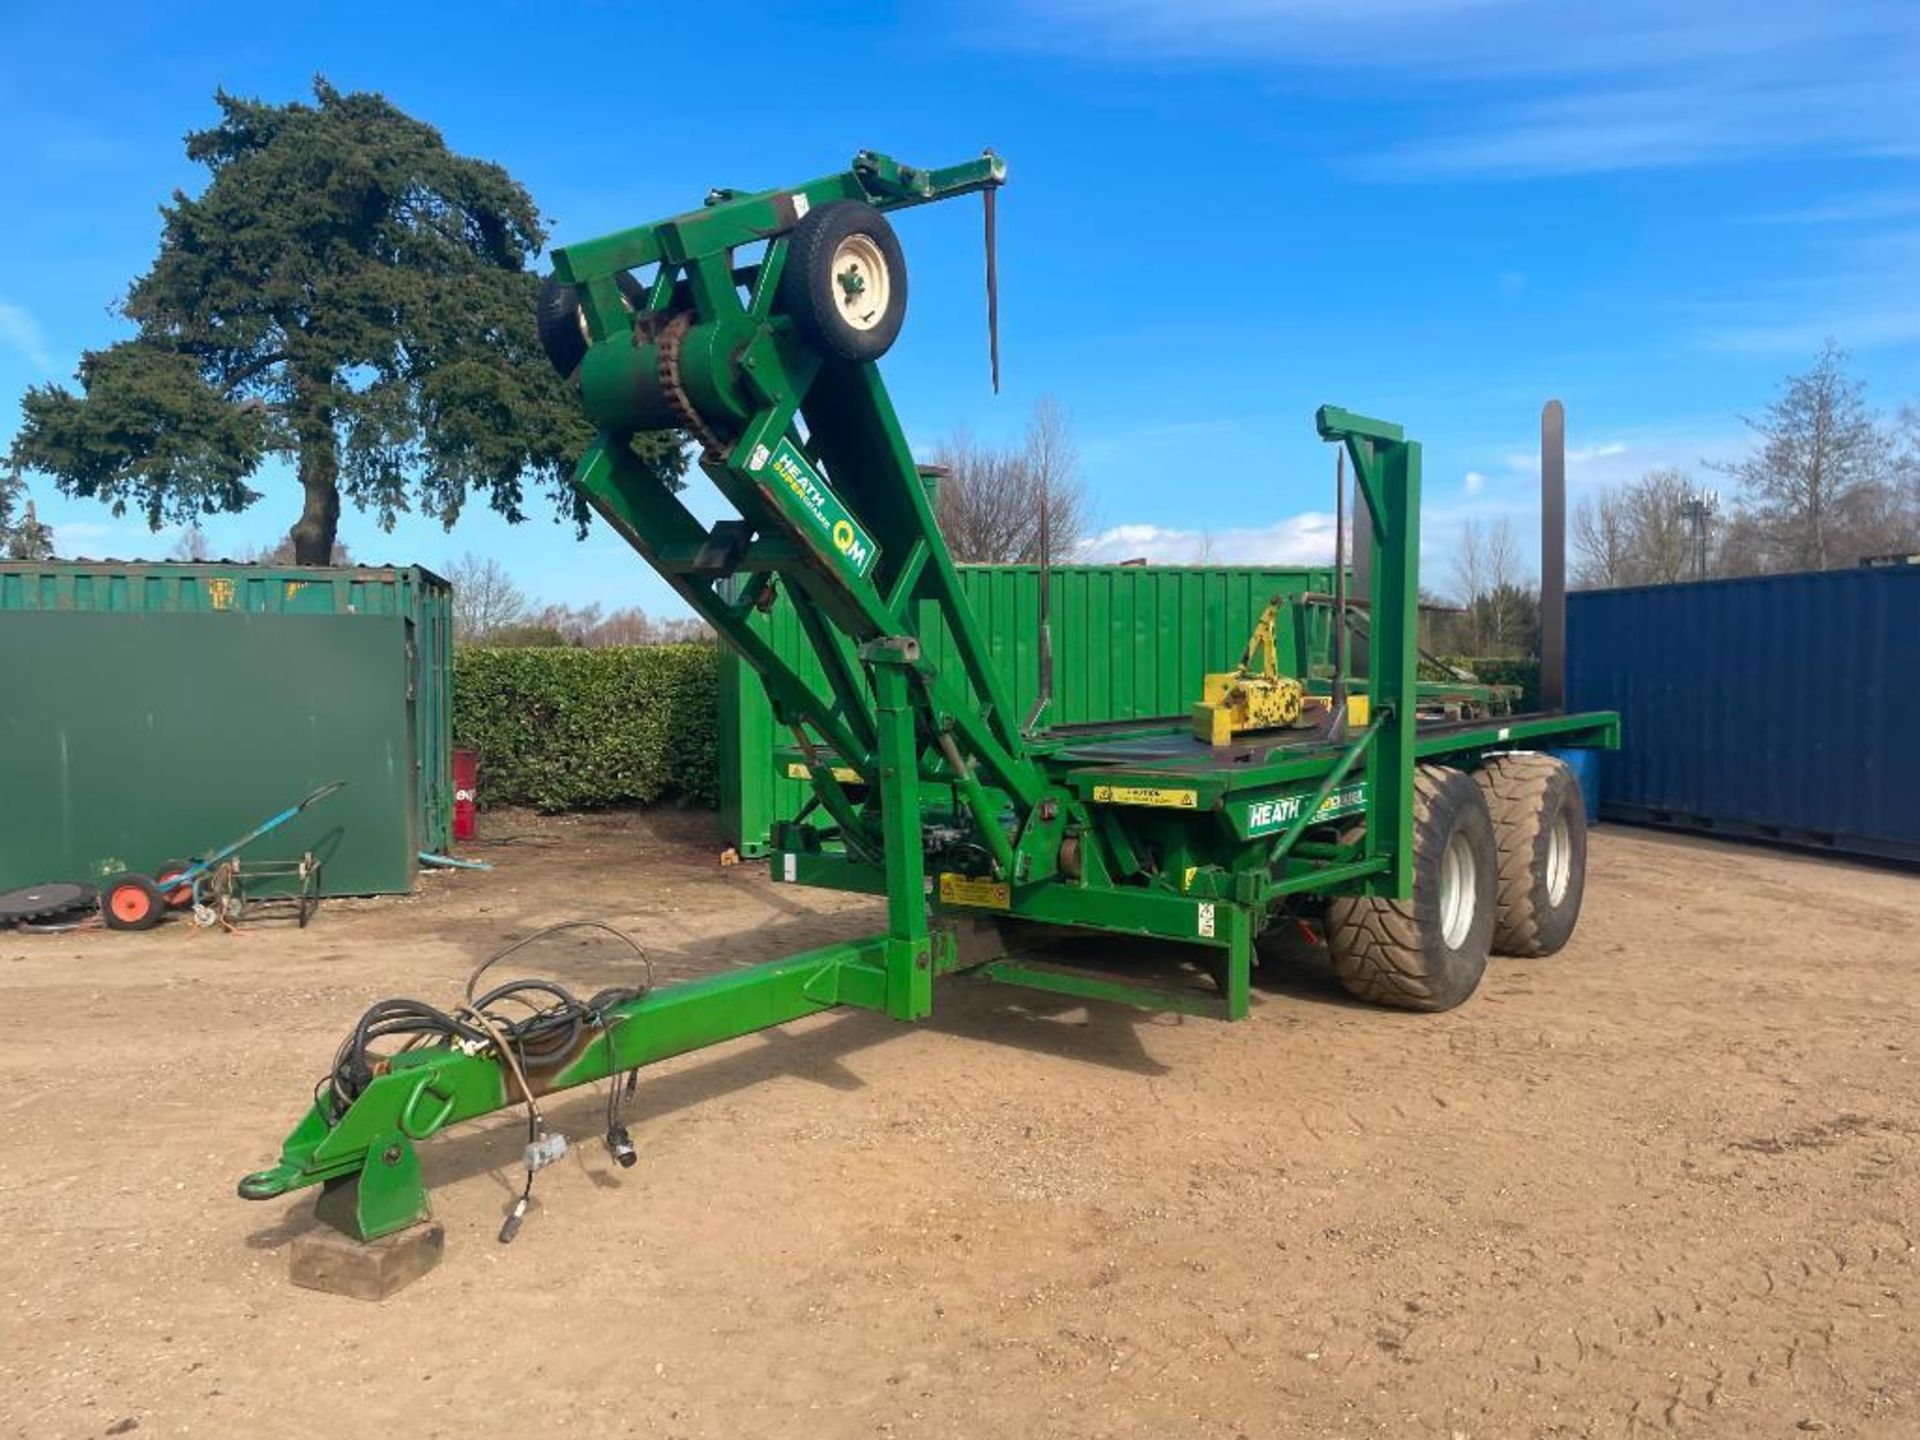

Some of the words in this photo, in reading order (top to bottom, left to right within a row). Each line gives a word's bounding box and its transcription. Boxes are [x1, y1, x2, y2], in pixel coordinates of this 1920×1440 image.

[779, 453, 825, 507] HEATH
[833, 519, 866, 568] QM
[1249, 799, 1301, 828] HEATH
